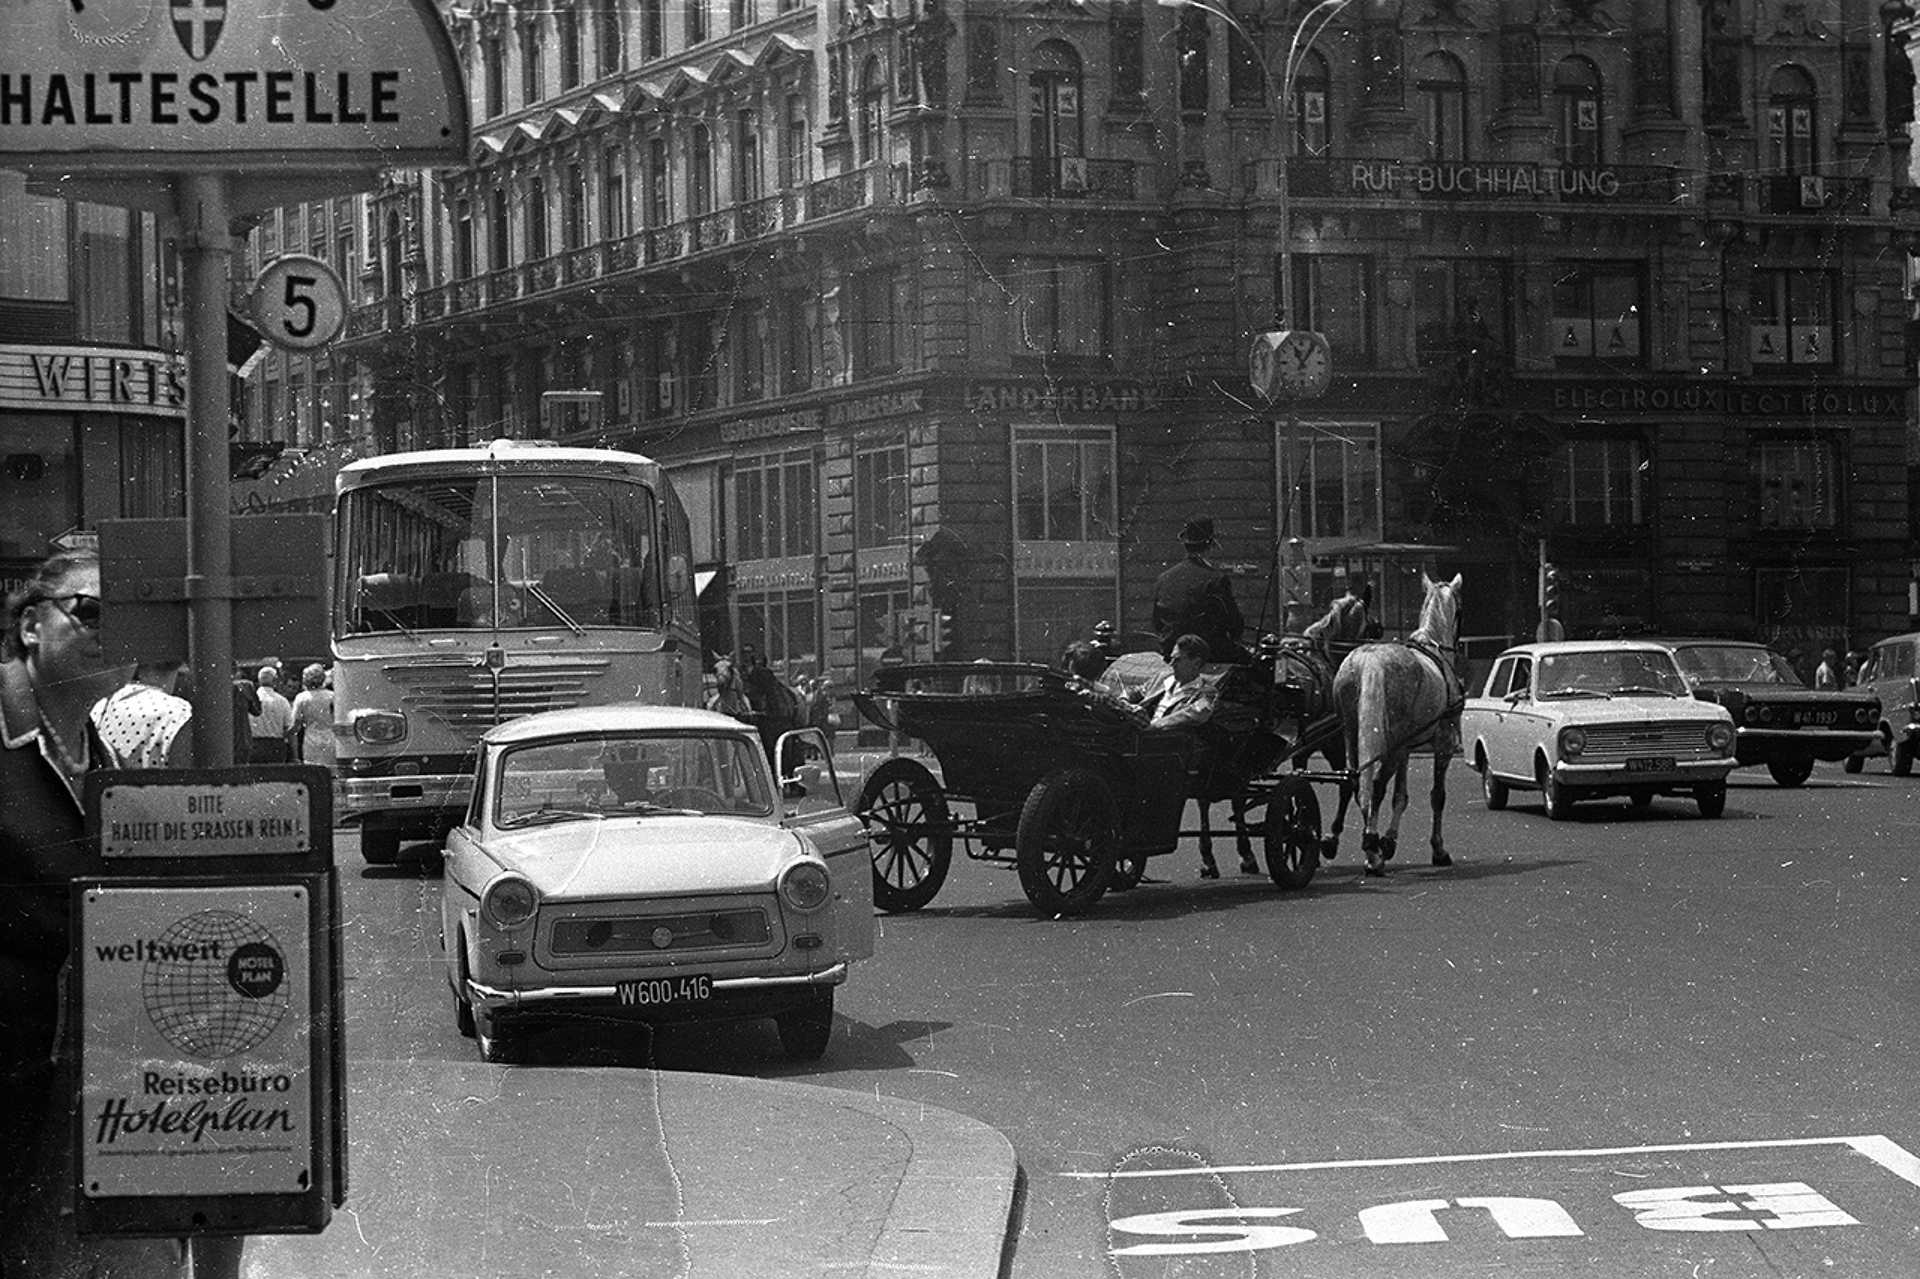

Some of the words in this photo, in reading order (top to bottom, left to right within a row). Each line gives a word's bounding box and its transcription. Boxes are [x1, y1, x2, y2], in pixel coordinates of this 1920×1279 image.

[1, 71, 400, 125] HALTESTELLE
[282, 275, 317, 338] 5
[1553, 387, 1719, 410] ELECTROLUX
[1726, 391, 1900, 414] LECTROLUX
[187, 795, 224, 814] BITTE
[111, 822, 159, 842] HALTET
[164, 821, 187, 841] DIE
[191, 819, 254, 840] STRASSEN
[95, 939, 222, 963] weltweit
[618, 975, 711, 1006] W600.416
[143, 1071, 291, 1096] Reisebüro
[96, 1097, 296, 1144] Hotelplan
[1108, 1181, 1860, 1256] BUS
